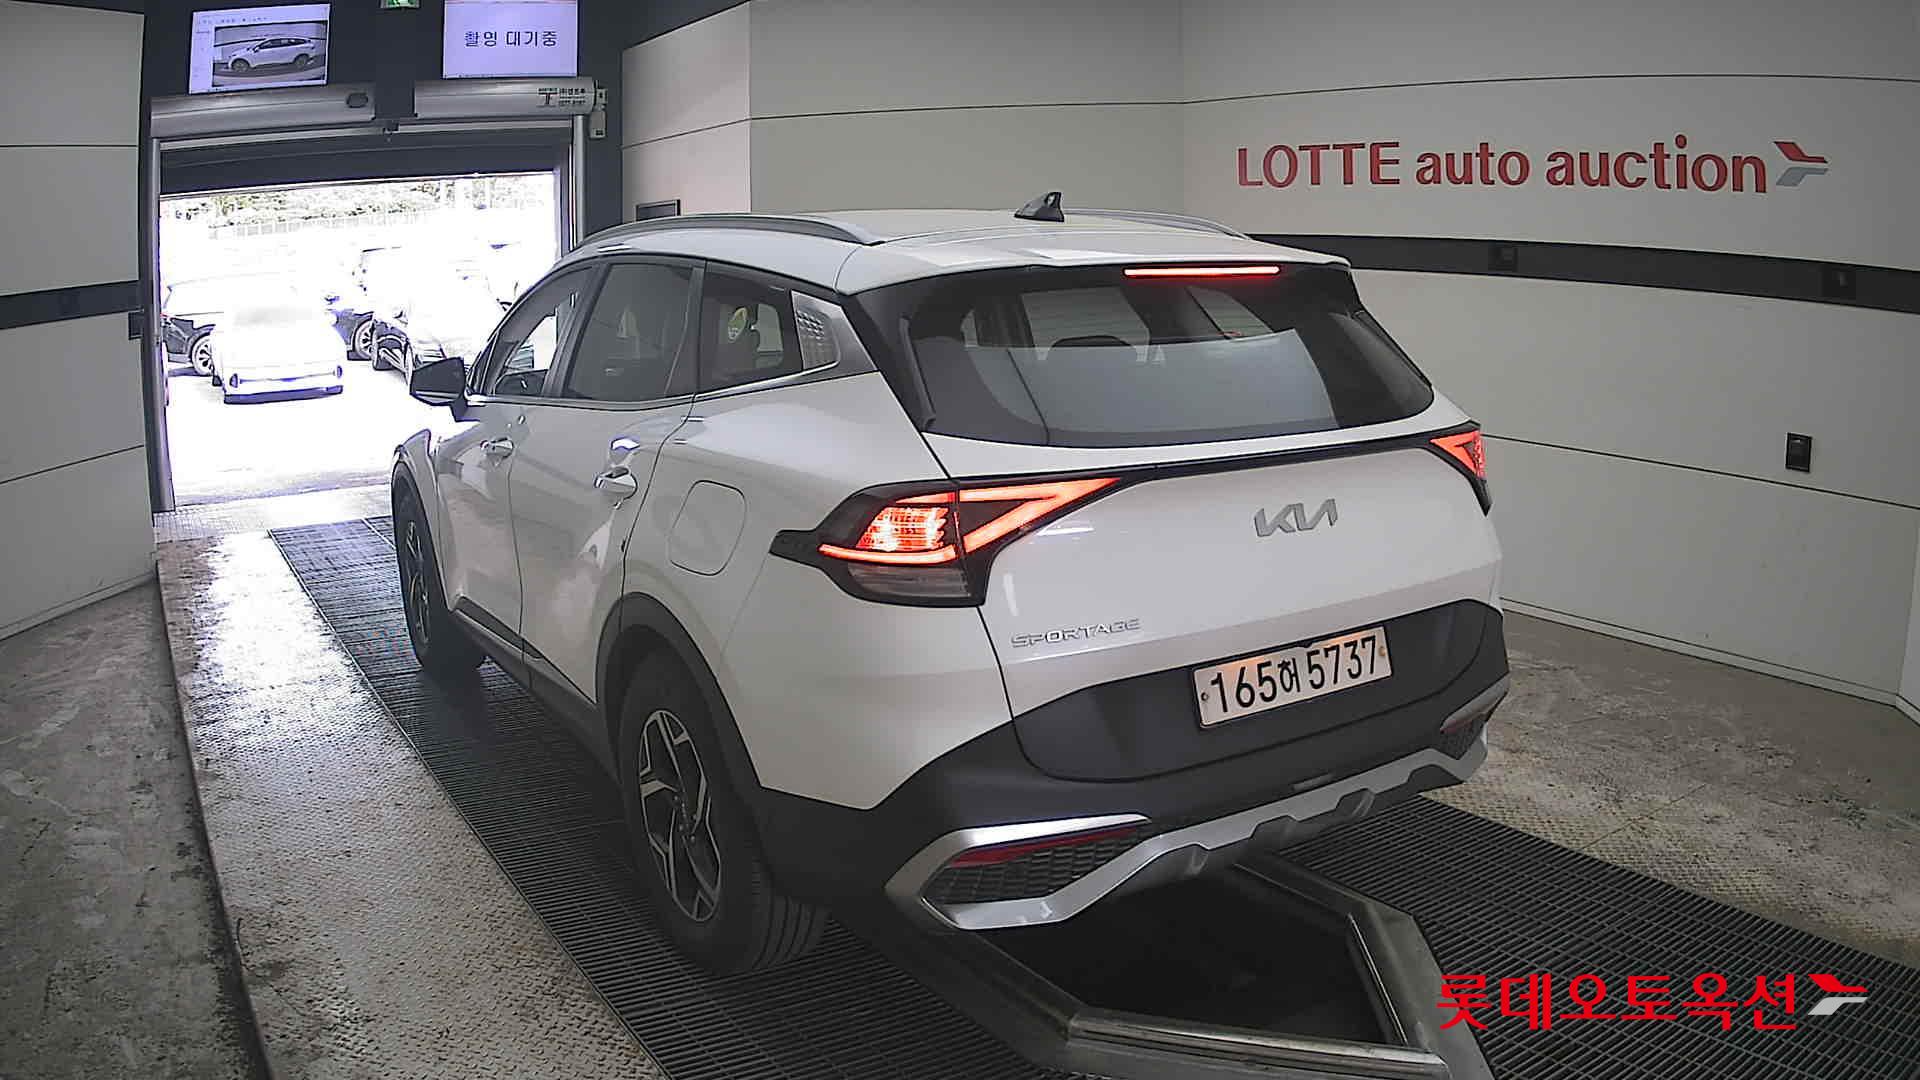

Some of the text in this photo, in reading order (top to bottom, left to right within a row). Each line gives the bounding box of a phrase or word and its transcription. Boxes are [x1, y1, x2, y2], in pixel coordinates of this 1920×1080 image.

[506, 31, 557, 47] 대기중
[1238, 134, 1767, 193] LOTTE auto auction
[1010, 618, 1142, 648] SPORTAGE
